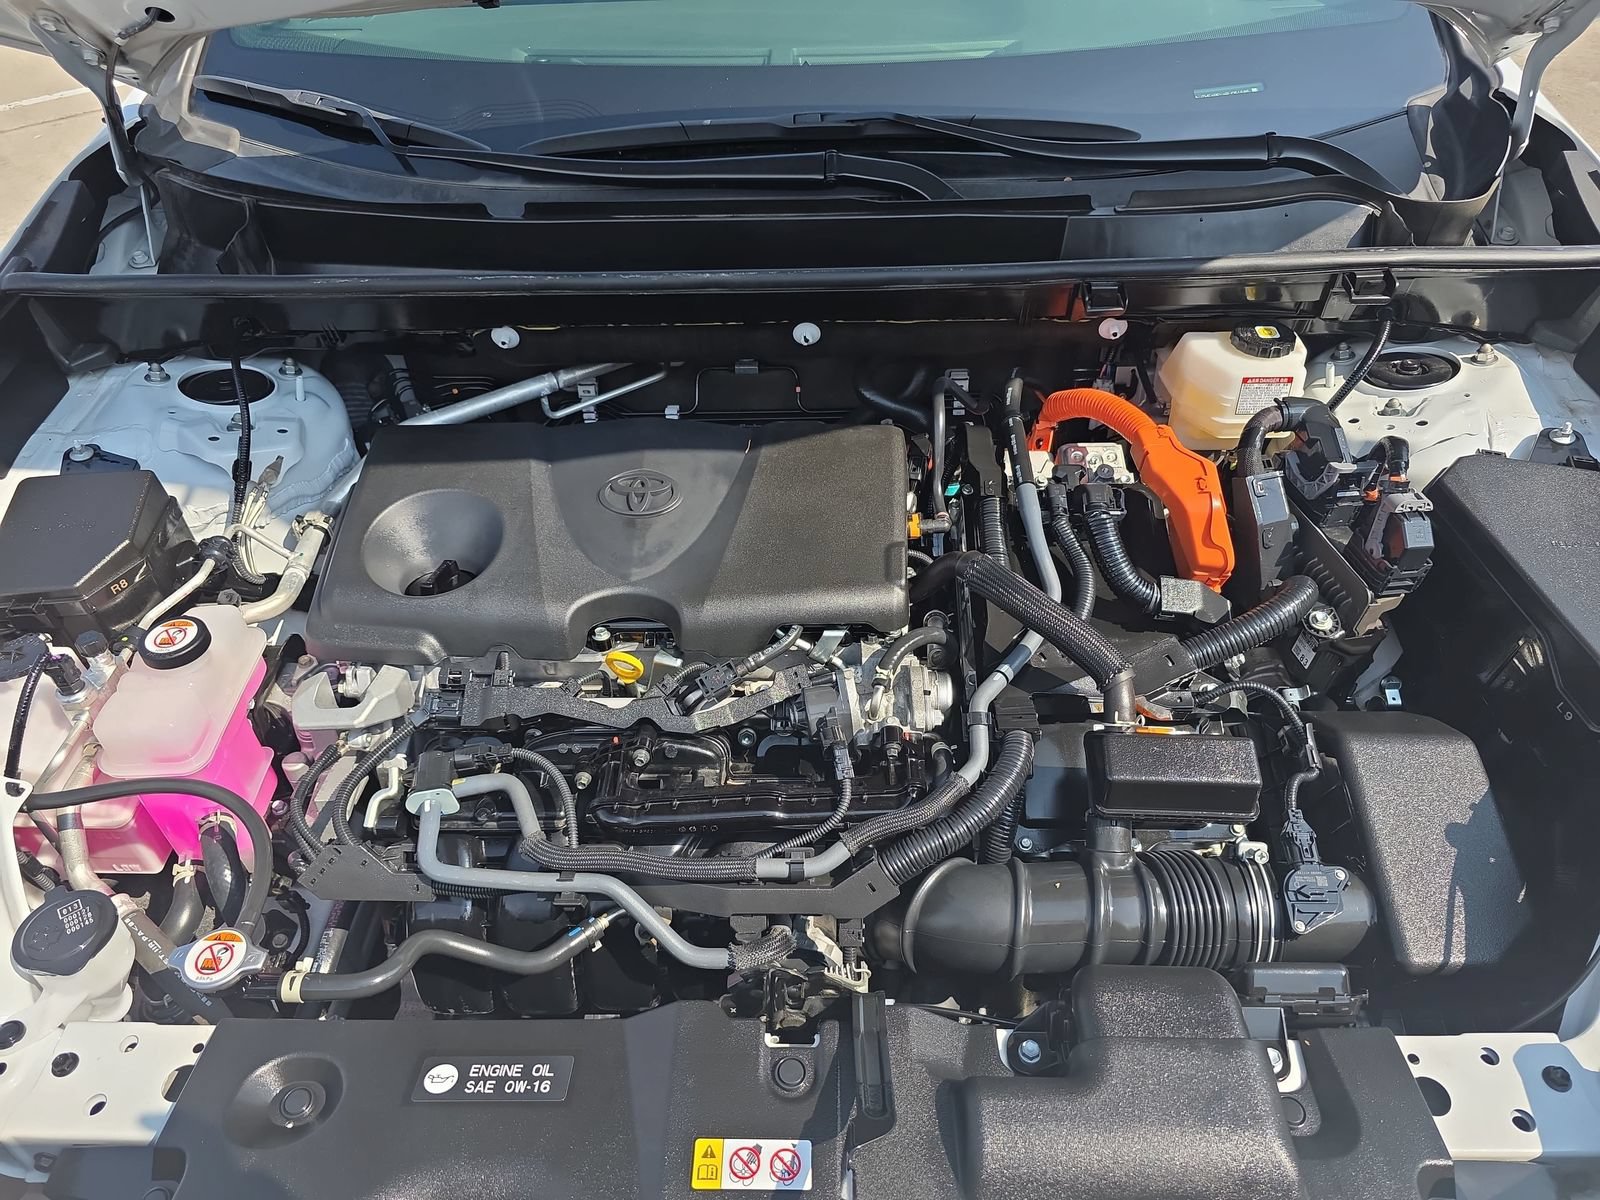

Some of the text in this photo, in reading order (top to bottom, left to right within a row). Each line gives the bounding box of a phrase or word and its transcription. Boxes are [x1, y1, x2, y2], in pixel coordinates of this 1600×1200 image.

[110, 579, 128, 595] R8
[1556, 701, 1573, 721] L9
[63, 906, 90, 924] 000127
[468, 1064, 555, 1077] ENGINE OIL
[464, 1080, 551, 1094] SAE 0W-16
